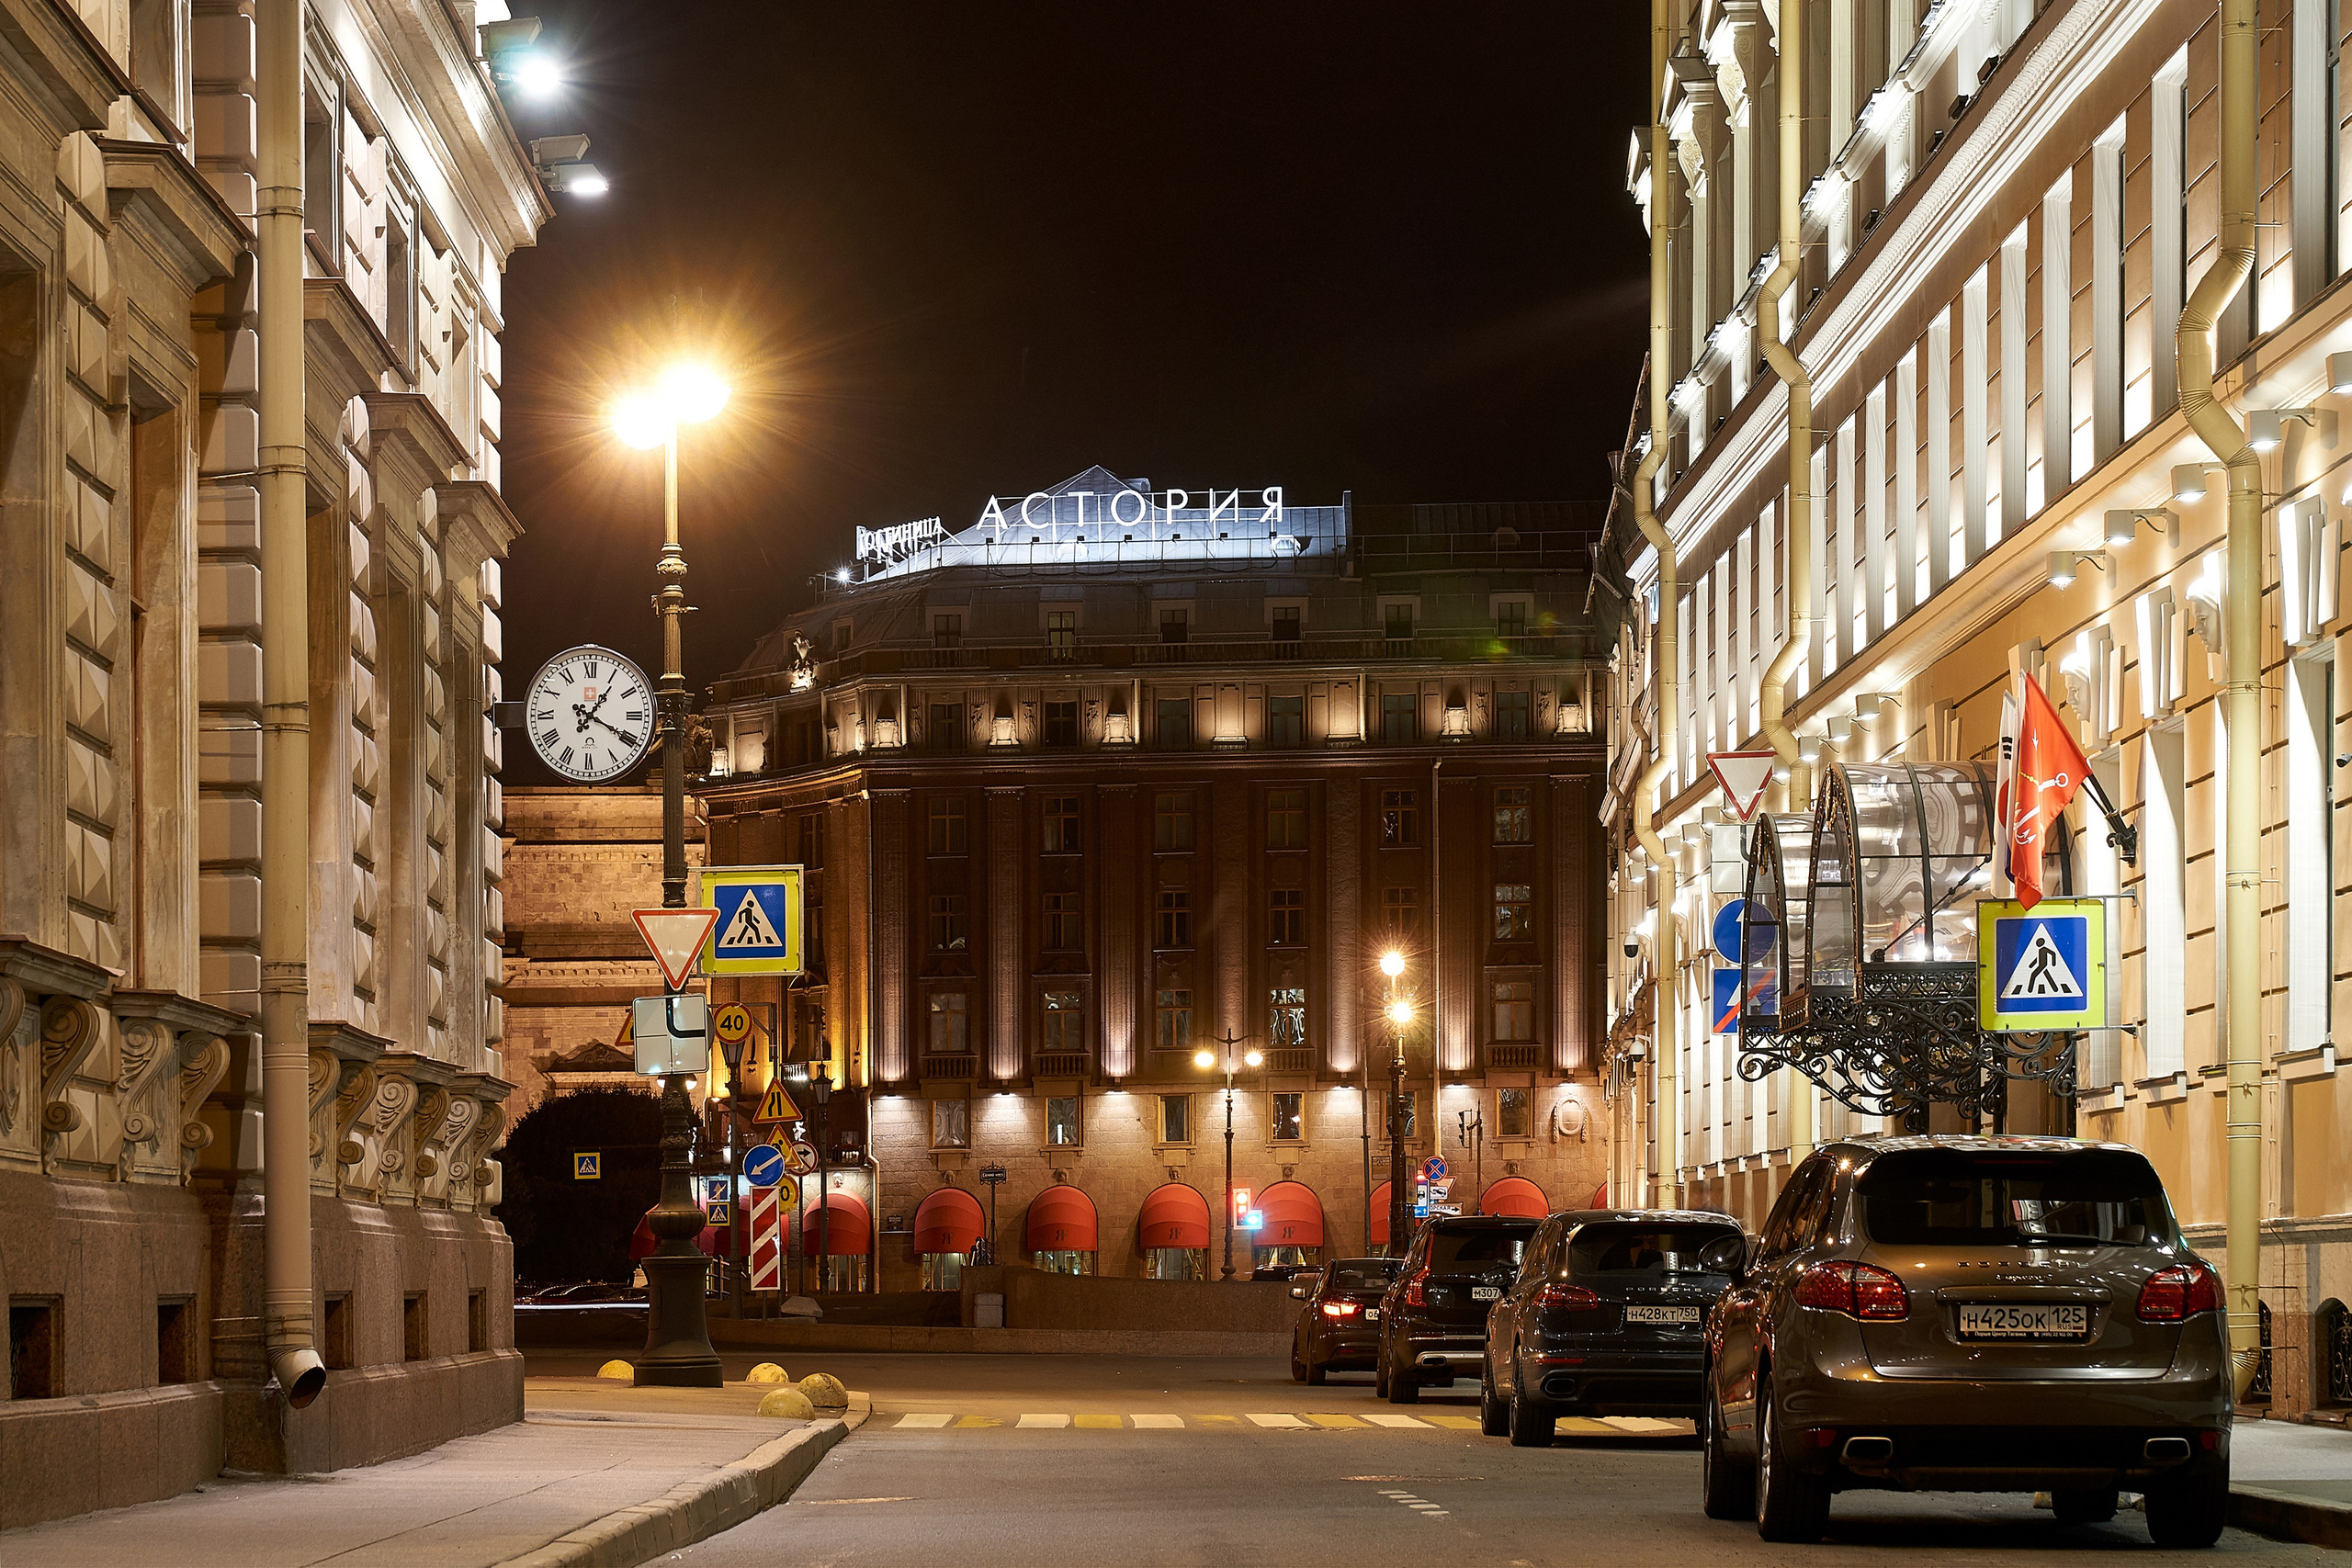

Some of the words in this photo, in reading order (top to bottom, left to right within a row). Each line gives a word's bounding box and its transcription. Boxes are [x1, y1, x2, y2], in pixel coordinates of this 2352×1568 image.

[976, 487, 1283, 531] АСТОРИЯ
[855, 516, 943, 559] ГОСТИНИЦА
[559, 667, 575, 686] XI
[583, 661, 597, 678] XII
[543, 686, 560, 699] X
[620, 686, 637, 699] II
[537, 709, 554, 720] IX
[626, 711, 642, 721] III
[541, 728, 560, 749] VIII
[559, 746, 575, 765] VII
[584, 752, 594, 770] VI
[607, 748, 618, 764] V
[720, 1014, 744, 1032] 40
[780, 1185, 790, 1201] 0
[1474, 1288, 1498, 1298] М307
[1631, 1308, 1677, 1320] Н428КТ
[1679, 1308, 1697, 1317] 750
[1967, 1308, 2046, 1329] Н425ОК
[2052, 1307, 2082, 1324] 125
